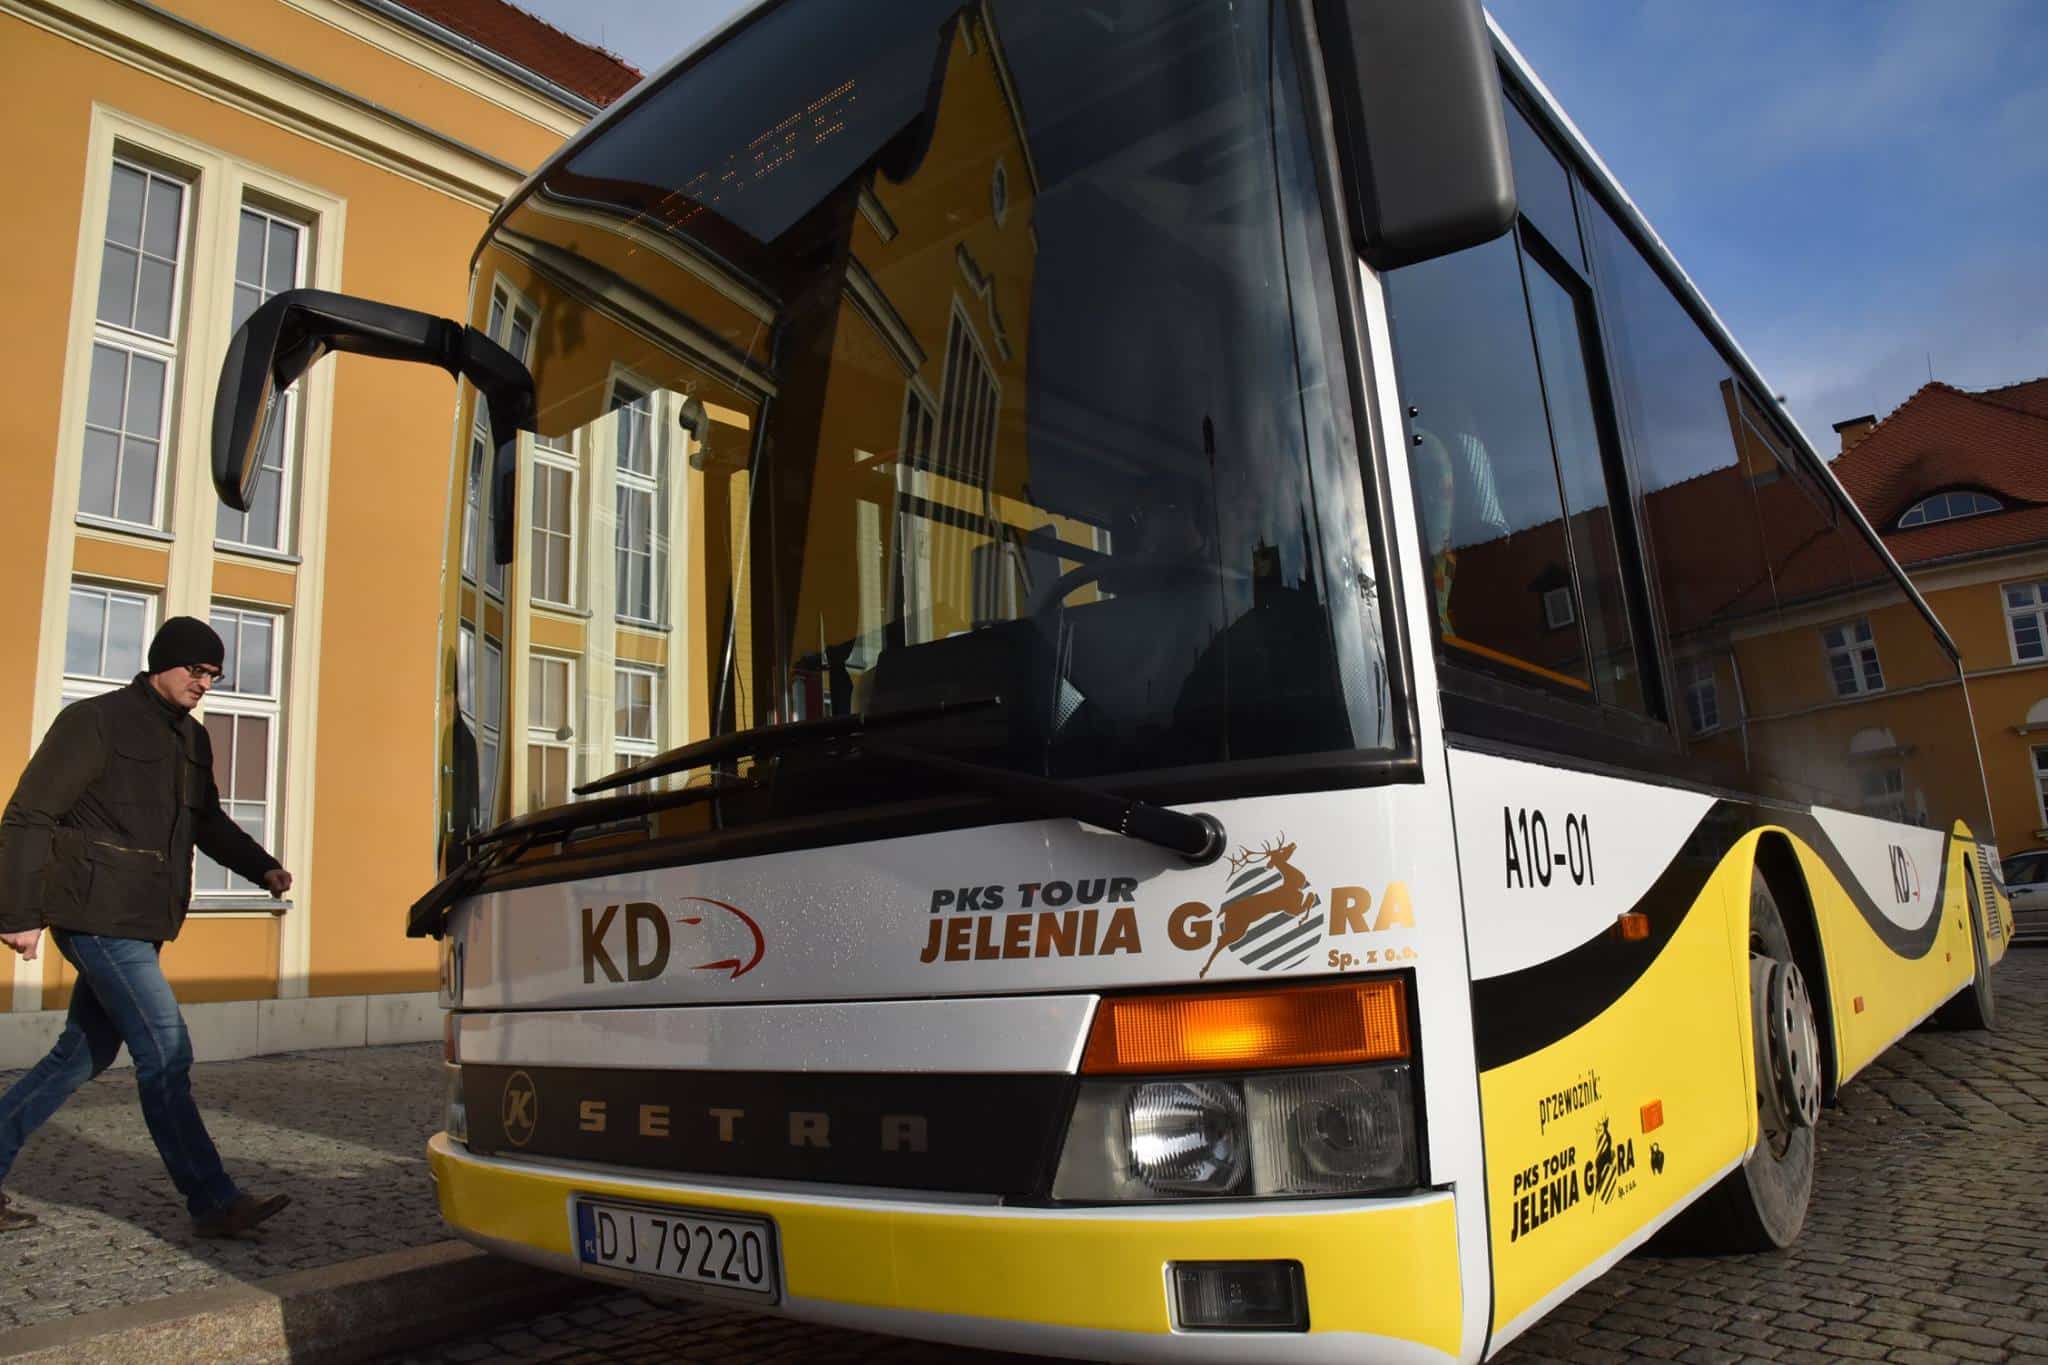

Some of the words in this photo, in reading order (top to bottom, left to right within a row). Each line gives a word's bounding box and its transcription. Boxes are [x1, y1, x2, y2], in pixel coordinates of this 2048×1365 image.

[1504, 806, 1594, 888] A10-01
[1888, 844, 1910, 904] KD
[920, 907, 1142, 964] JELENIA
[1168, 862, 1418, 972] GRA
[929, 883, 1004, 913] PKS
[1018, 877, 1139, 909] TOUR
[581, 902, 671, 984] KD
[1328, 948, 1360, 971] Sp.
[1366, 950, 1377, 963] z
[579, 1100, 928, 1153] SETRA
[1511, 1170, 1579, 1243] JELENIA
[1584, 1134, 1635, 1199] GRA
[1513, 1164, 1539, 1197] PKS
[1543, 1146, 1576, 1178] TOUR
[598, 1212, 637, 1264] DJ
[651, 1219, 763, 1284] 79220
